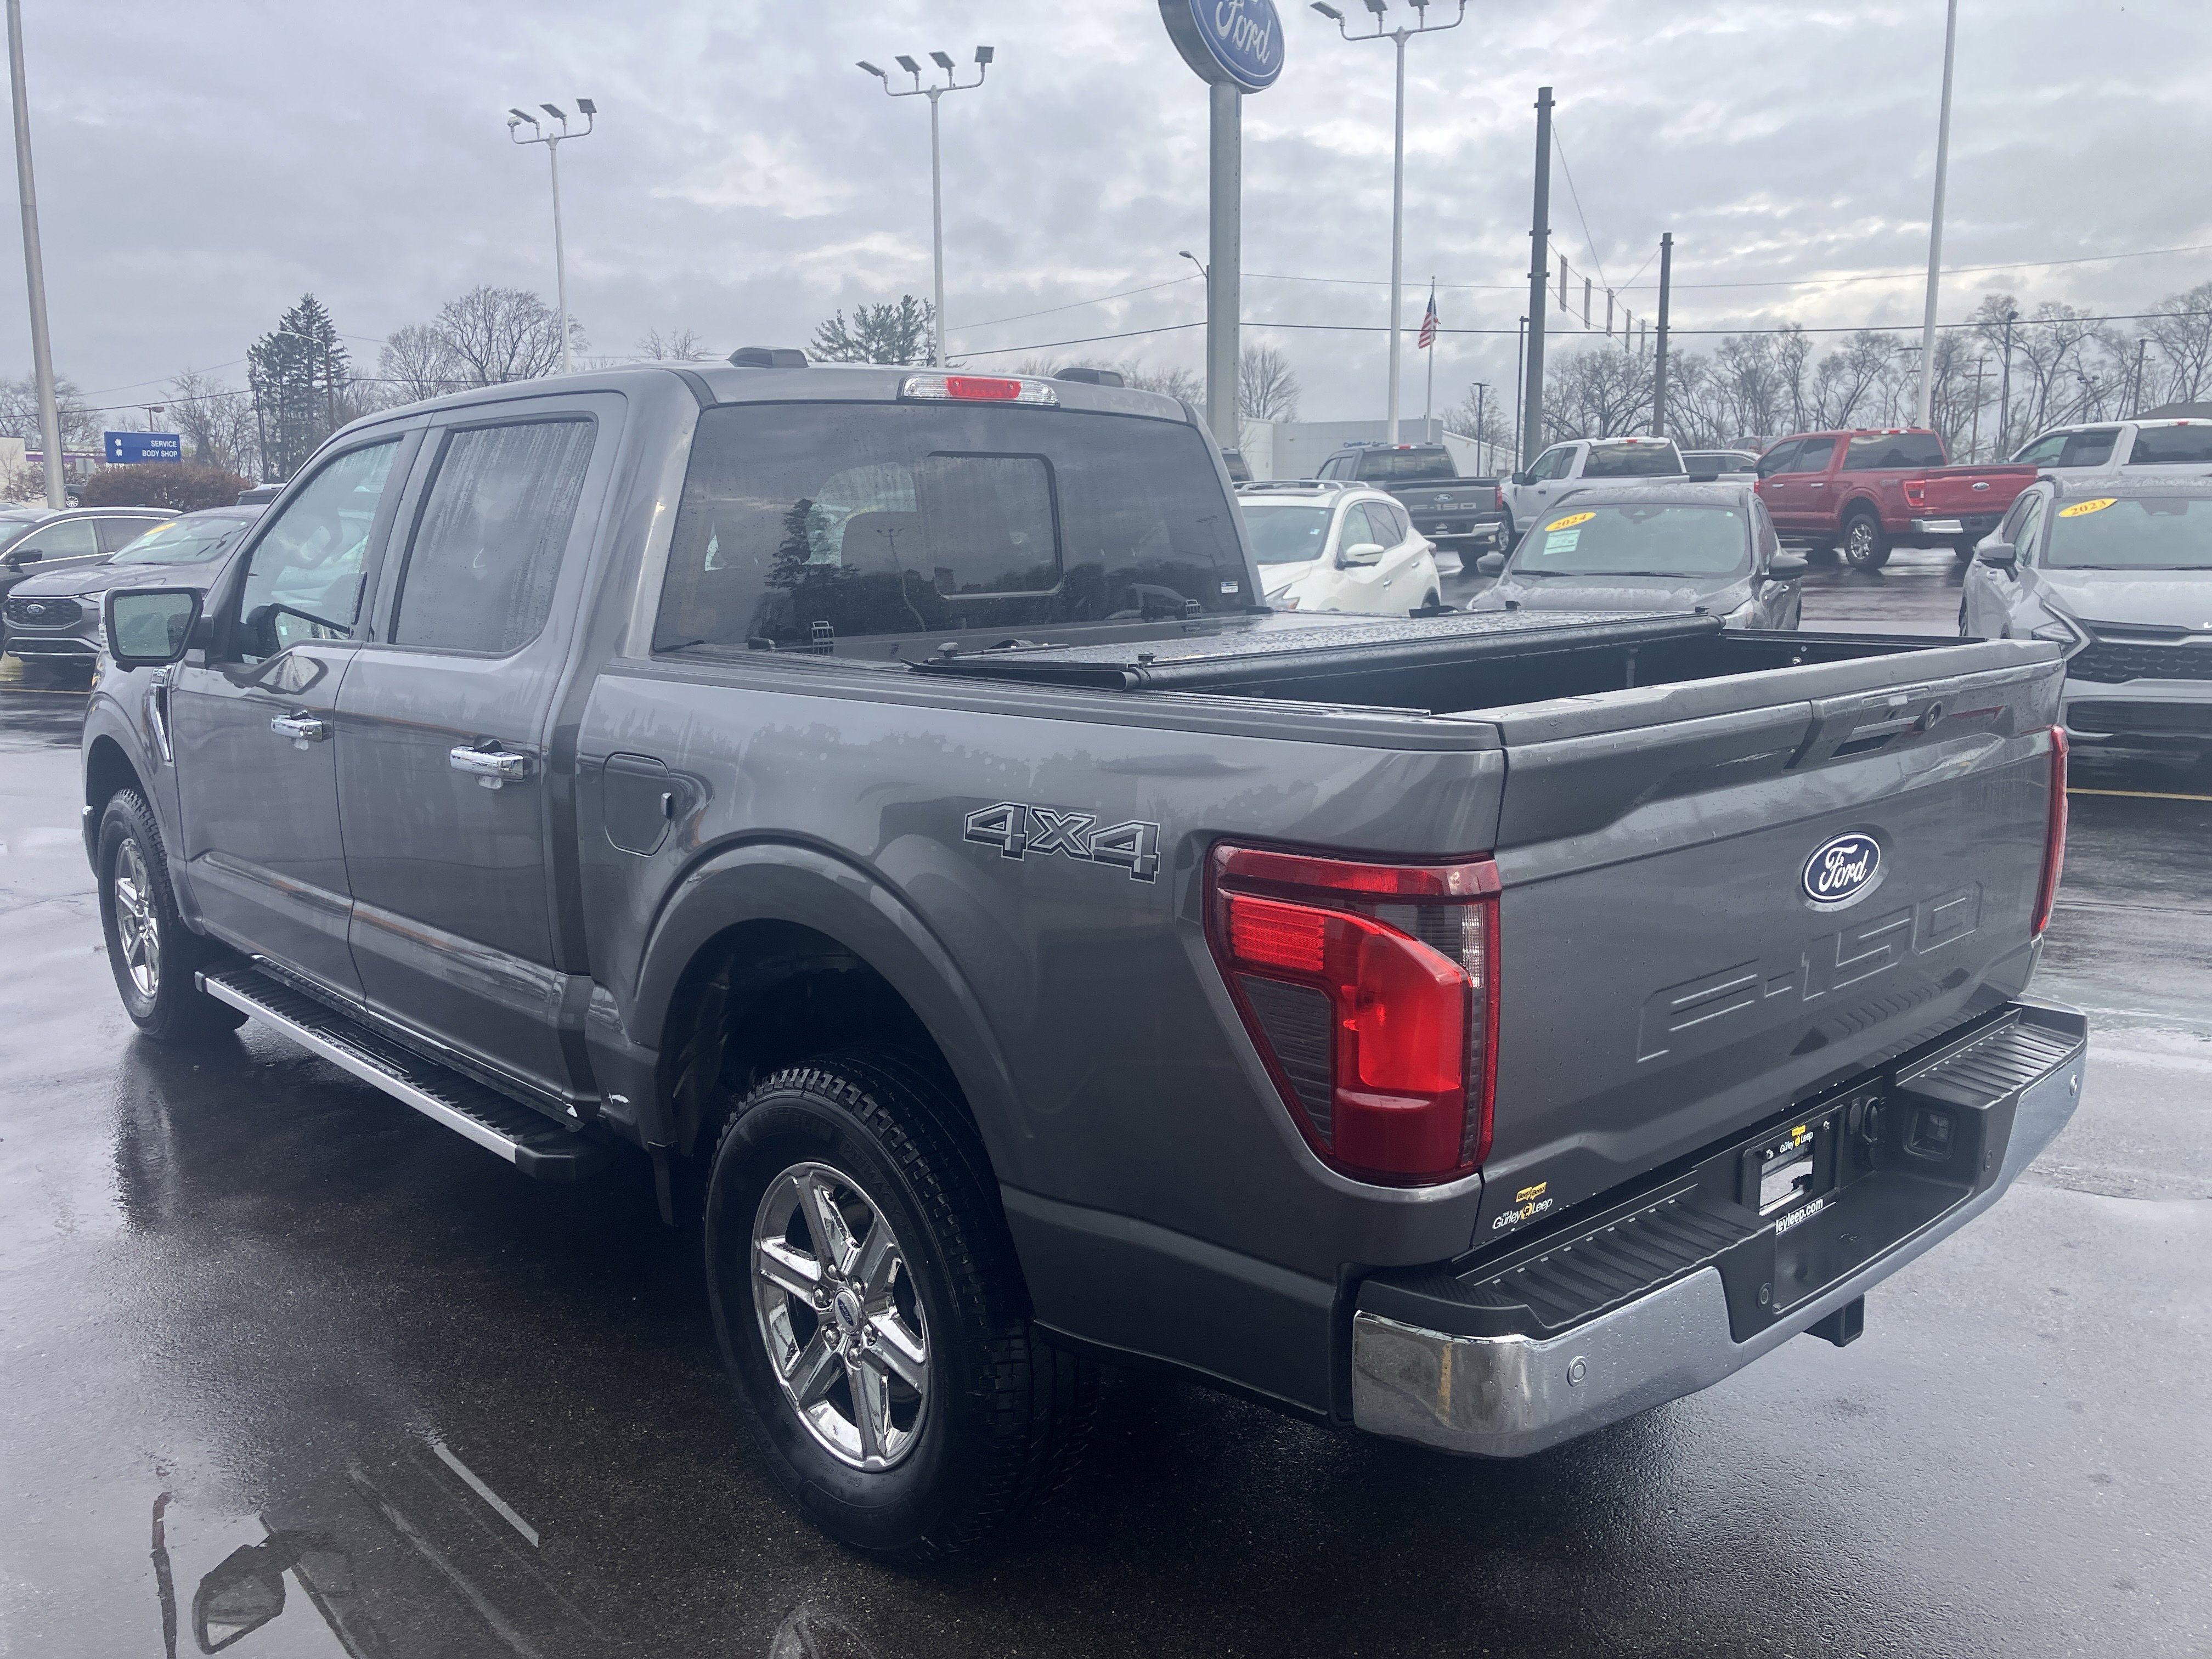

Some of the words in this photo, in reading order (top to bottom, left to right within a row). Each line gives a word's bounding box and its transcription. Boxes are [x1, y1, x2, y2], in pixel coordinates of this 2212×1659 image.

[1215, 0, 1272, 64] Ford
[1409, 502, 1477, 511] F-150
[2070, 500, 2106, 515] 2023
[1819, 844, 1869, 892] Ford
[1637, 880, 1983, 1063] F-150
[1801, 1131, 1814, 1143] Leep
[1492, 1210, 1522, 1229] Gurley
[1531, 1198, 1553, 1214] Leep
[1776, 1198, 1823, 1233] leyleep.com
